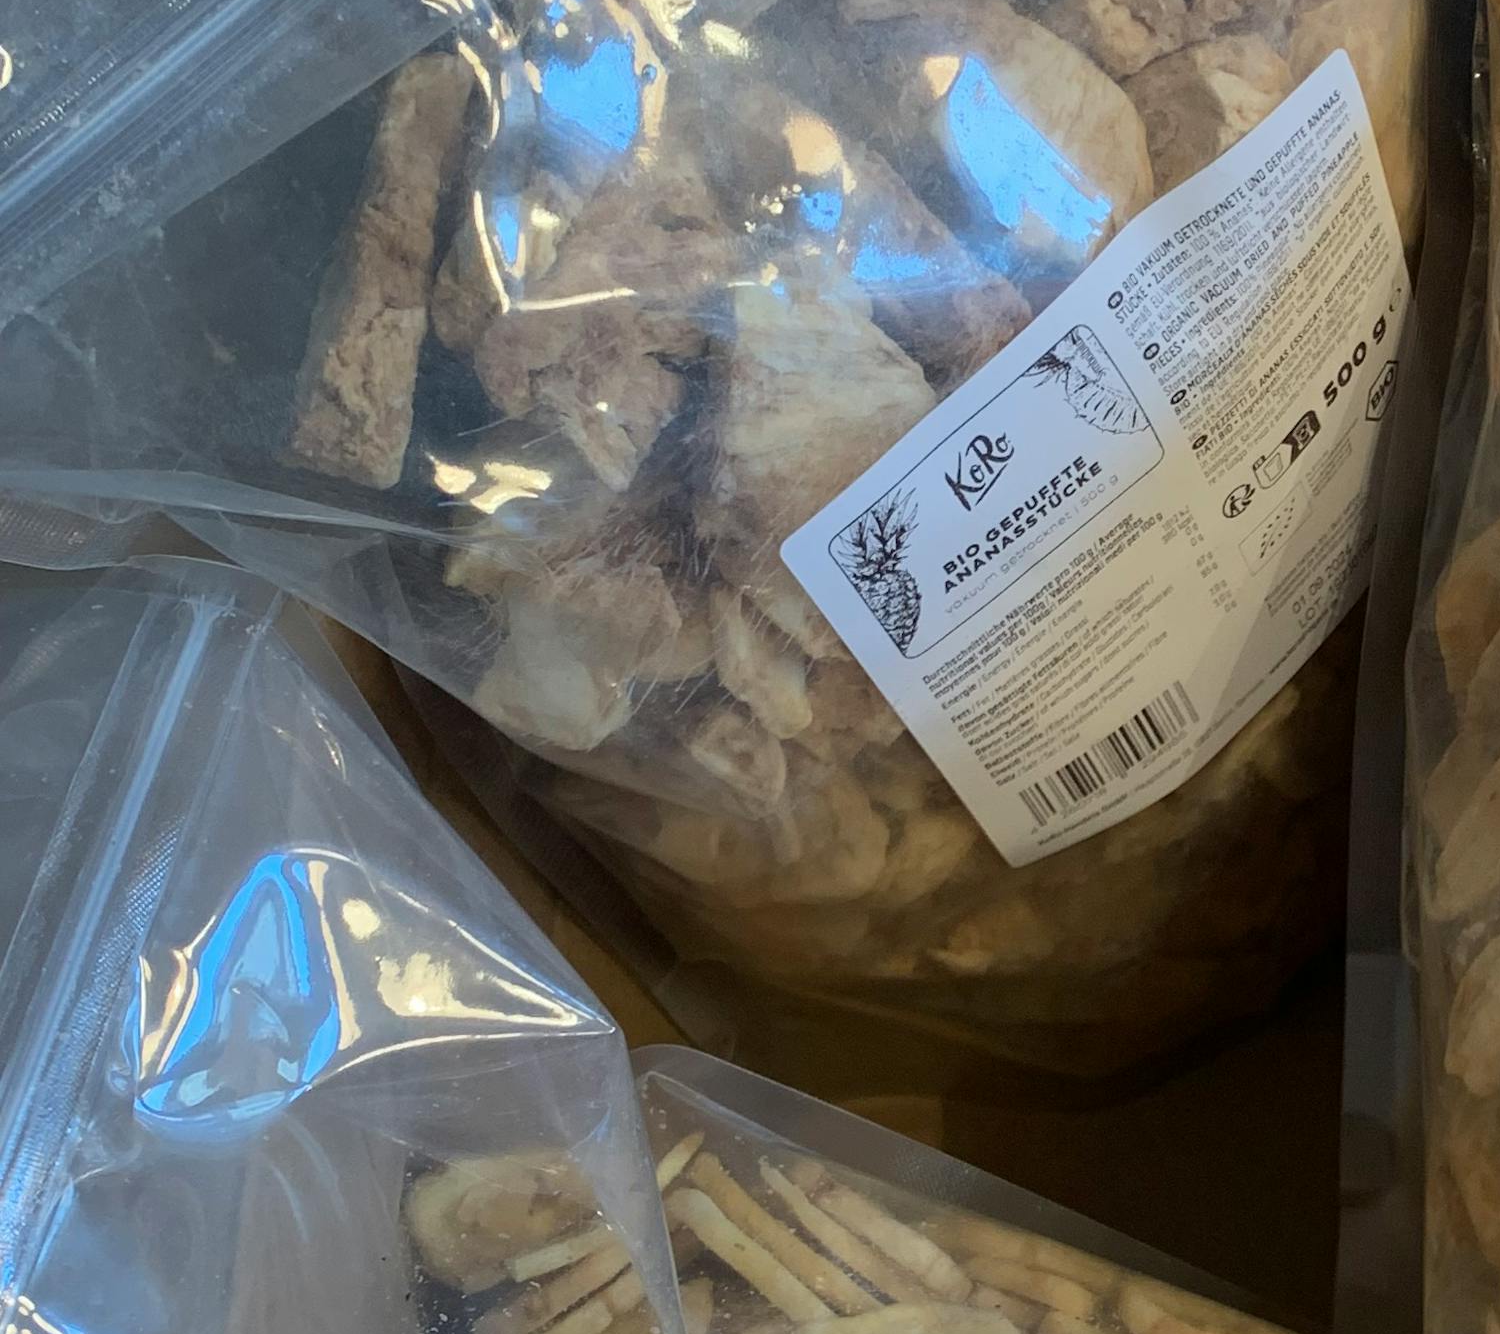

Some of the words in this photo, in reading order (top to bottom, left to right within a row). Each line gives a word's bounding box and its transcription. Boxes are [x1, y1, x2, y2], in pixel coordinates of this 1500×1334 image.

[1136, 239, 1175, 277] VAKUUM
[1173, 187, 1246, 244] GETROCKNETE
[1245, 169, 1266, 191] UND
[1265, 126, 1307, 173] GEPUFFTE
[1161, 301, 1200, 343] ORGANIC
[1200, 268, 1243, 303] VACUUM
[1244, 240, 1269, 270] DRIED
[1266, 217, 1288, 241] AND
[1290, 182, 1319, 218] PUFFED
[1316, 131, 1358, 181] PINEAPPLE
[1115, 289, 1148, 324] STÜCKE
[1151, 249, 1192, 284] Zutaten:
[1184, 294, 1239, 341] Ingredients:
[1323, 341, 1366, 407] 500
[1373, 315, 1386, 345] g
[943, 544, 980, 575] BIO
[986, 456, 1086, 542] GEPUFFTE
[945, 433, 1014, 511] KoRo
[945, 462, 1102, 594] ANANASSTÜCKE
[945, 572, 998, 613] vakuum
